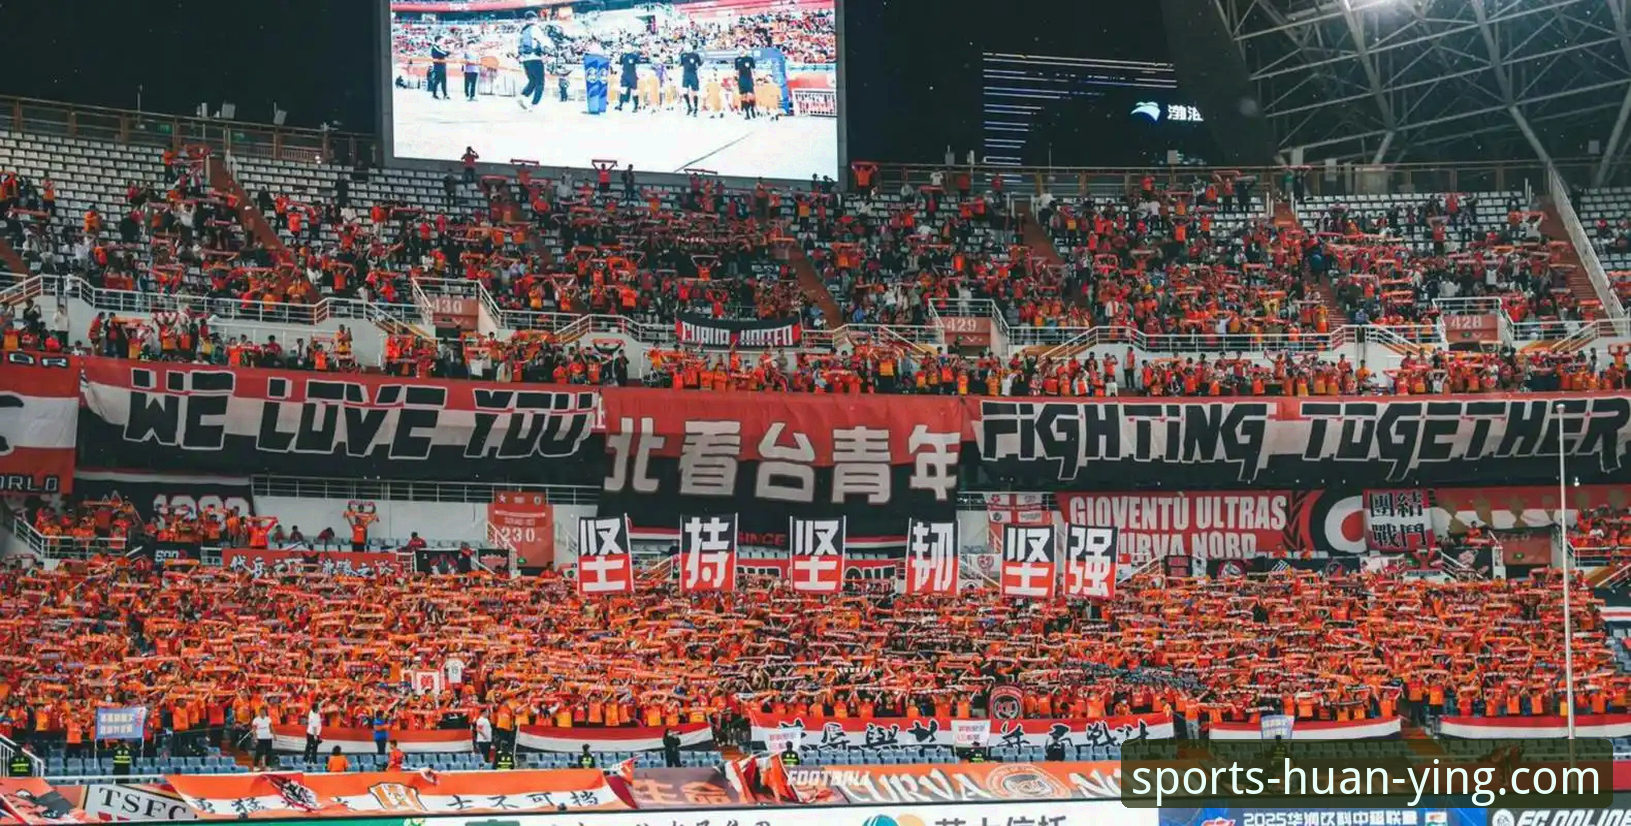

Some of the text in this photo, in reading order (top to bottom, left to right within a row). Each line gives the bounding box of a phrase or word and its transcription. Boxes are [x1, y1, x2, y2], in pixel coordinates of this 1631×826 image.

[946, 317, 976, 332] 429
[1450, 315, 1482, 330] 428
[123, 367, 597, 459] WE LOVE YOU
[980, 397, 1631, 482] FIGHTING TOGETHER
[602, 414, 962, 504] 北看台青年
[500, 526, 536, 543] 230
[1069, 490, 1287, 530] GIOVENTÙ ULTRAS
[579, 519, 626, 592] 坚
[685, 517, 732, 588] 持
[794, 520, 839, 591] 坚
[911, 521, 957, 592] 韧
[1003, 527, 1050, 596] 坚
[1068, 526, 1113, 597] 强
[1117, 533, 1257, 558] URVA NORD
[100, 788, 187, 819] TSFC
[1517, 810, 1550, 826] FC
